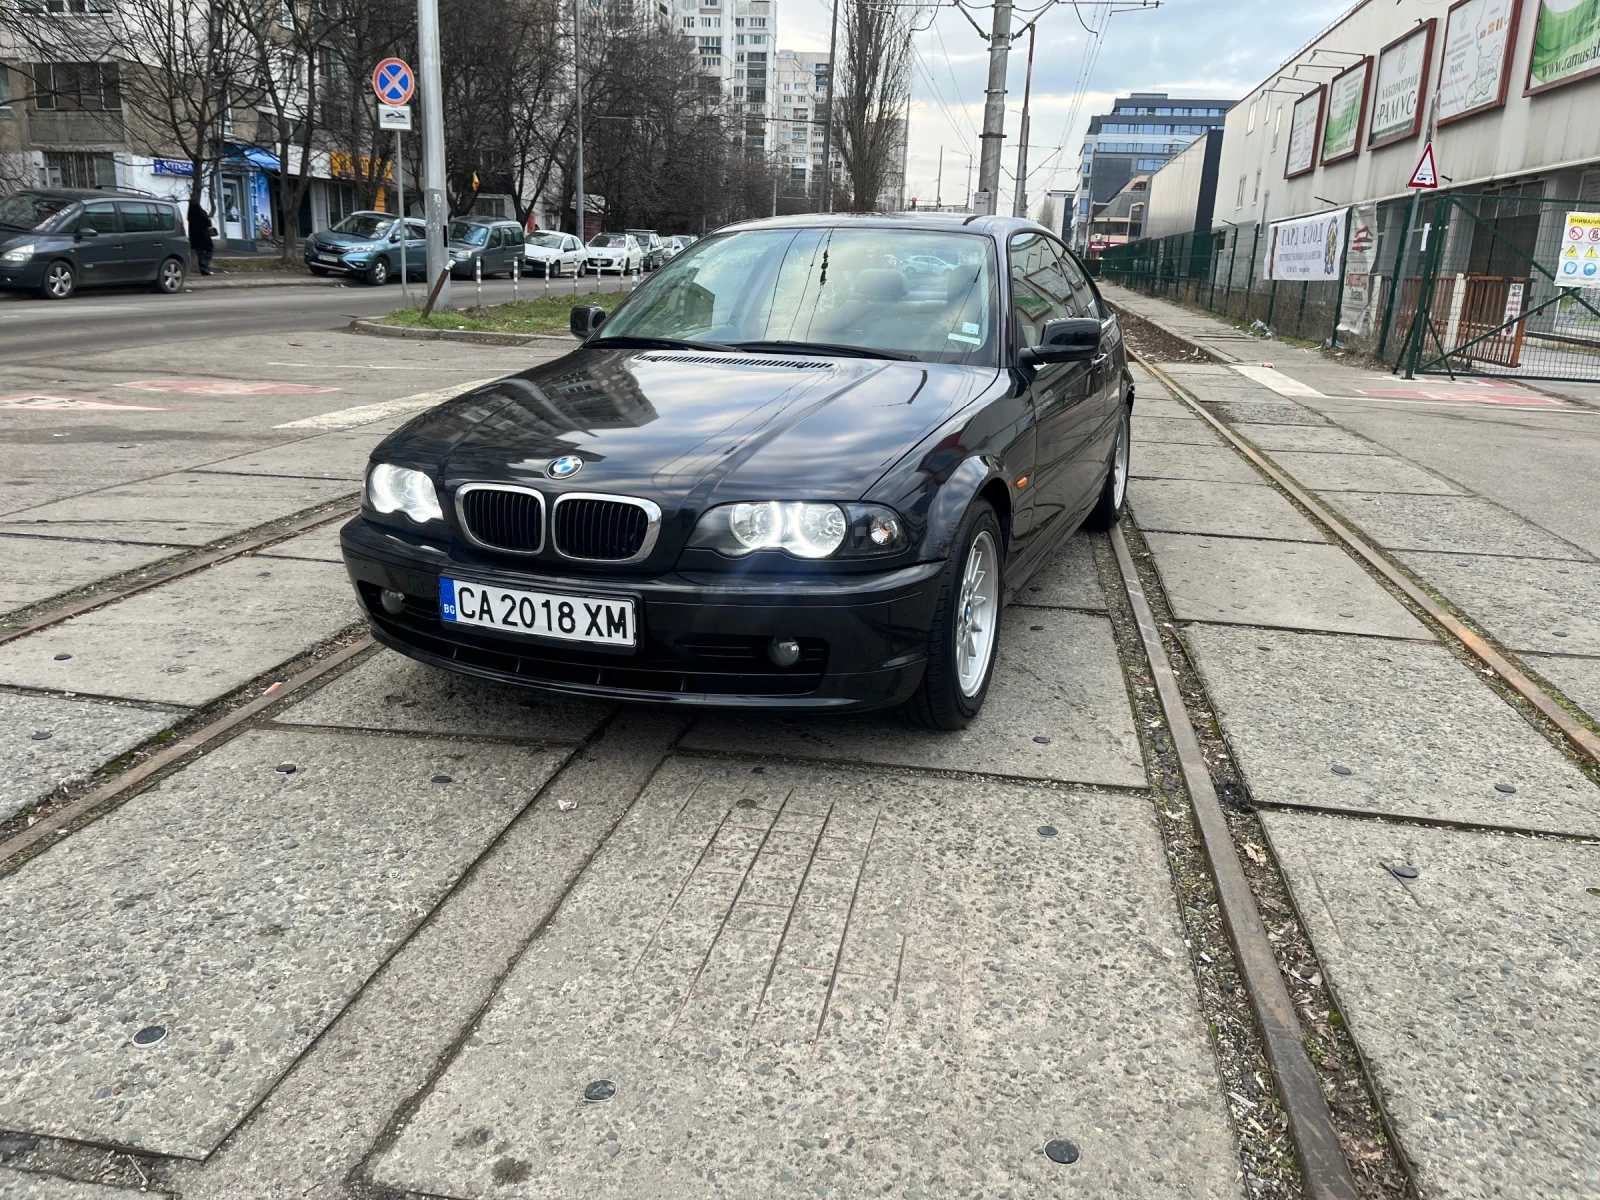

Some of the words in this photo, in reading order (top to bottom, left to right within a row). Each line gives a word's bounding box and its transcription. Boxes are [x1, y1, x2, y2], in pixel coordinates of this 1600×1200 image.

[443, 604, 455, 615] BG
[458, 586, 495, 623] CA
[500, 593, 576, 634] 2018
[583, 602, 627, 639] XM
